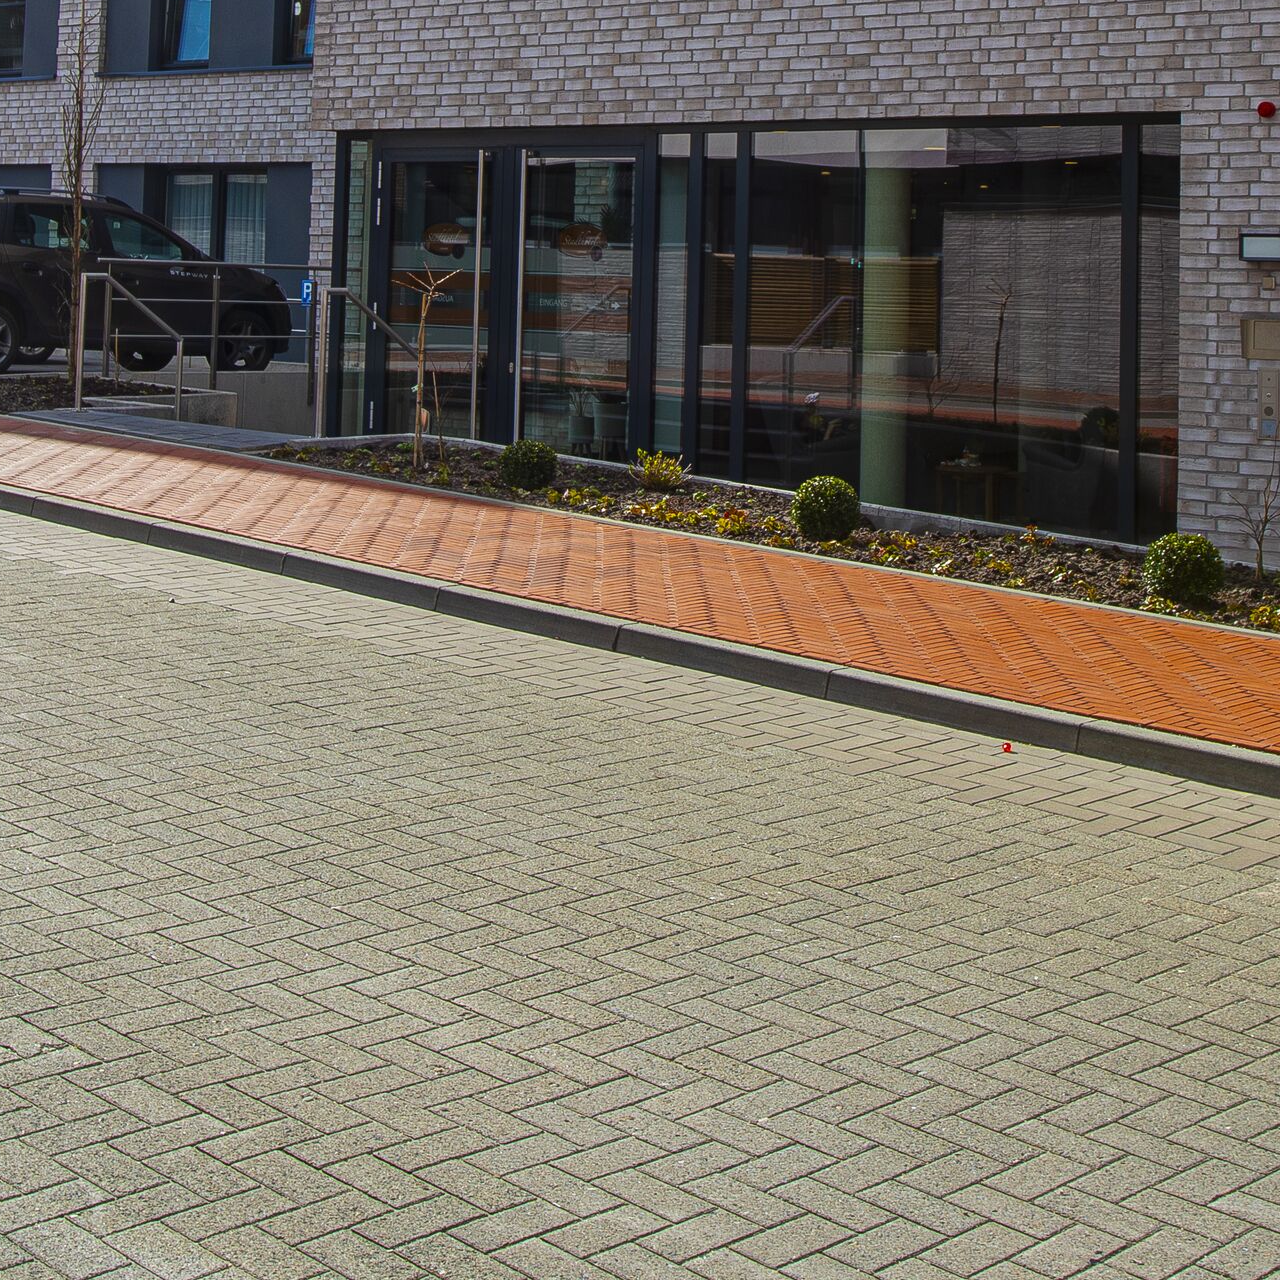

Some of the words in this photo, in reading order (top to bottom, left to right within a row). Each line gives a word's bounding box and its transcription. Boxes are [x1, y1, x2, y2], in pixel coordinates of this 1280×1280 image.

[169, 270, 209, 280] STEPWAY
[303, 282, 312, 299] P
[539, 298, 568, 308] EINGANG
